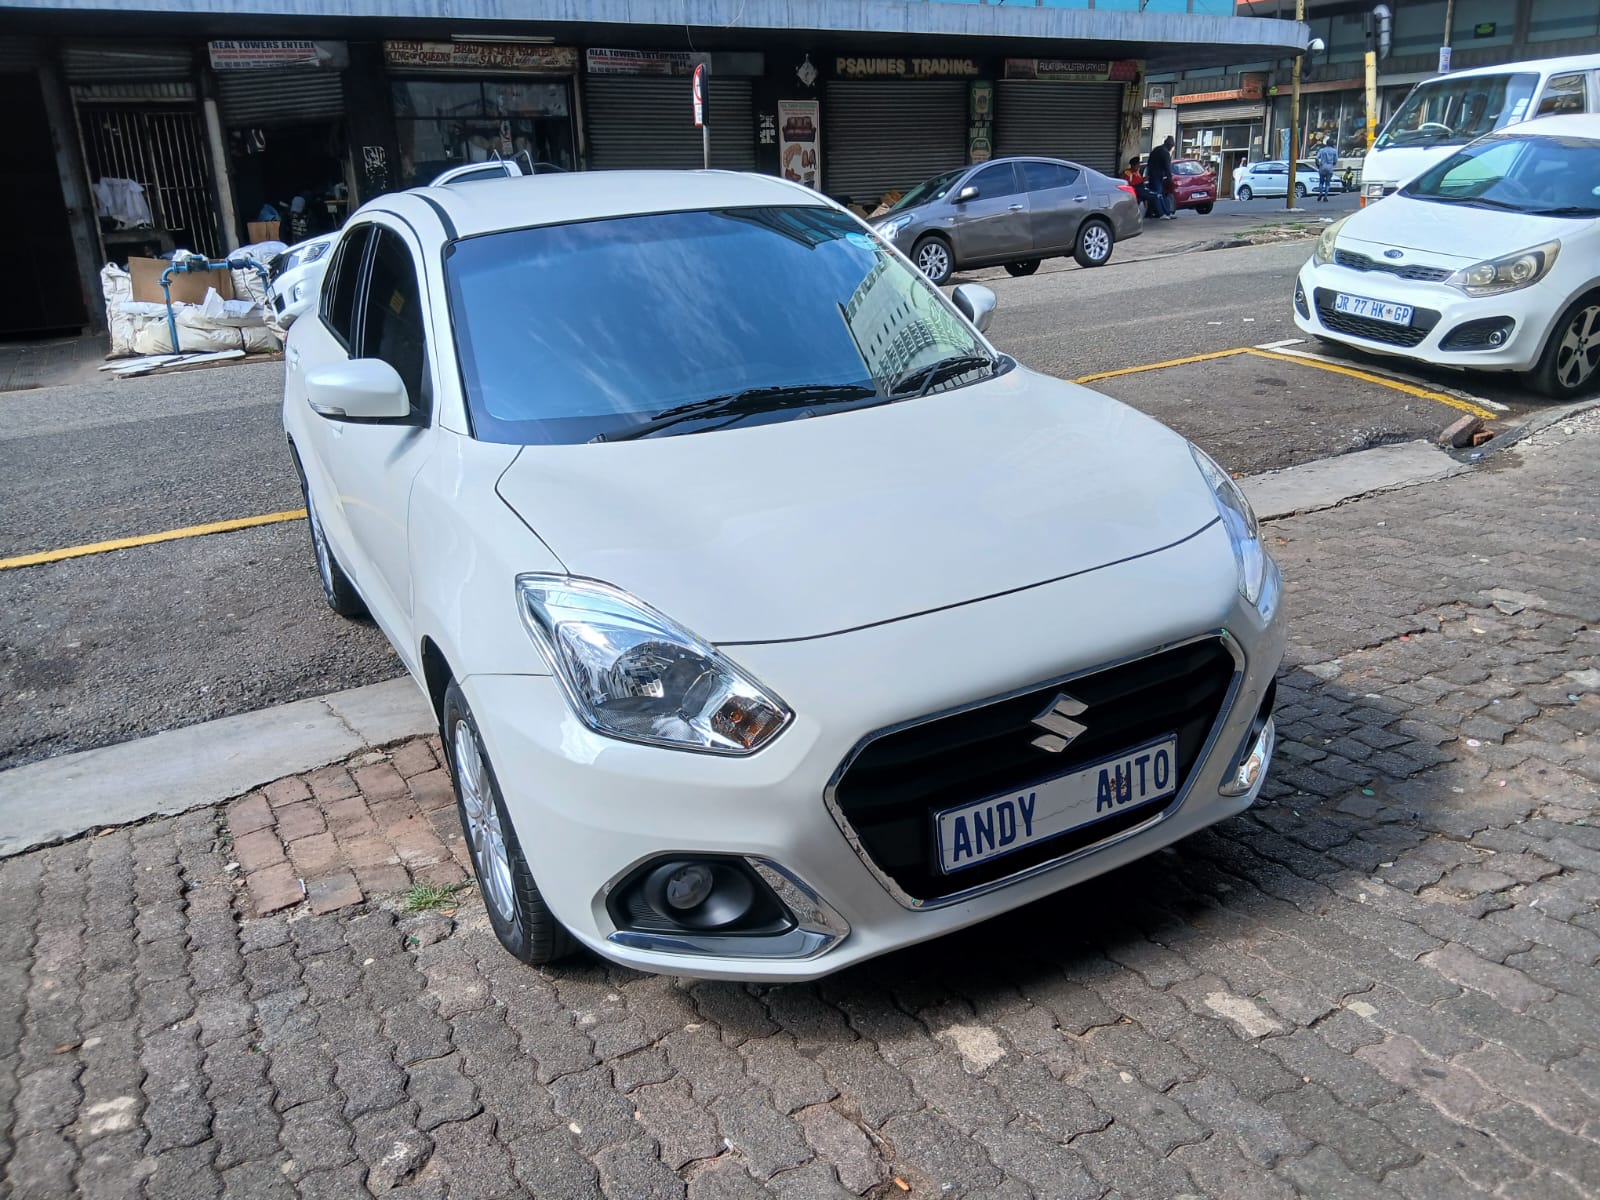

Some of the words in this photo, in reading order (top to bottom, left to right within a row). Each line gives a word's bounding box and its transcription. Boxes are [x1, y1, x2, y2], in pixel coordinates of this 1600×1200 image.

[212, 41, 235, 49] REAL
[238, 41, 279, 49] TOWERS
[479, 54, 515, 65] SALON
[836, 57, 906, 75] PSAUMES
[911, 58, 973, 75] TRADING
[1337, 294, 1349, 311] JR
[1353, 298, 1367, 314] 77
[1371, 302, 1386, 318] HK
[1393, 306, 1410, 323] GP
[953, 792, 1036, 862] ANDY
[1096, 749, 1169, 813] AUTO
